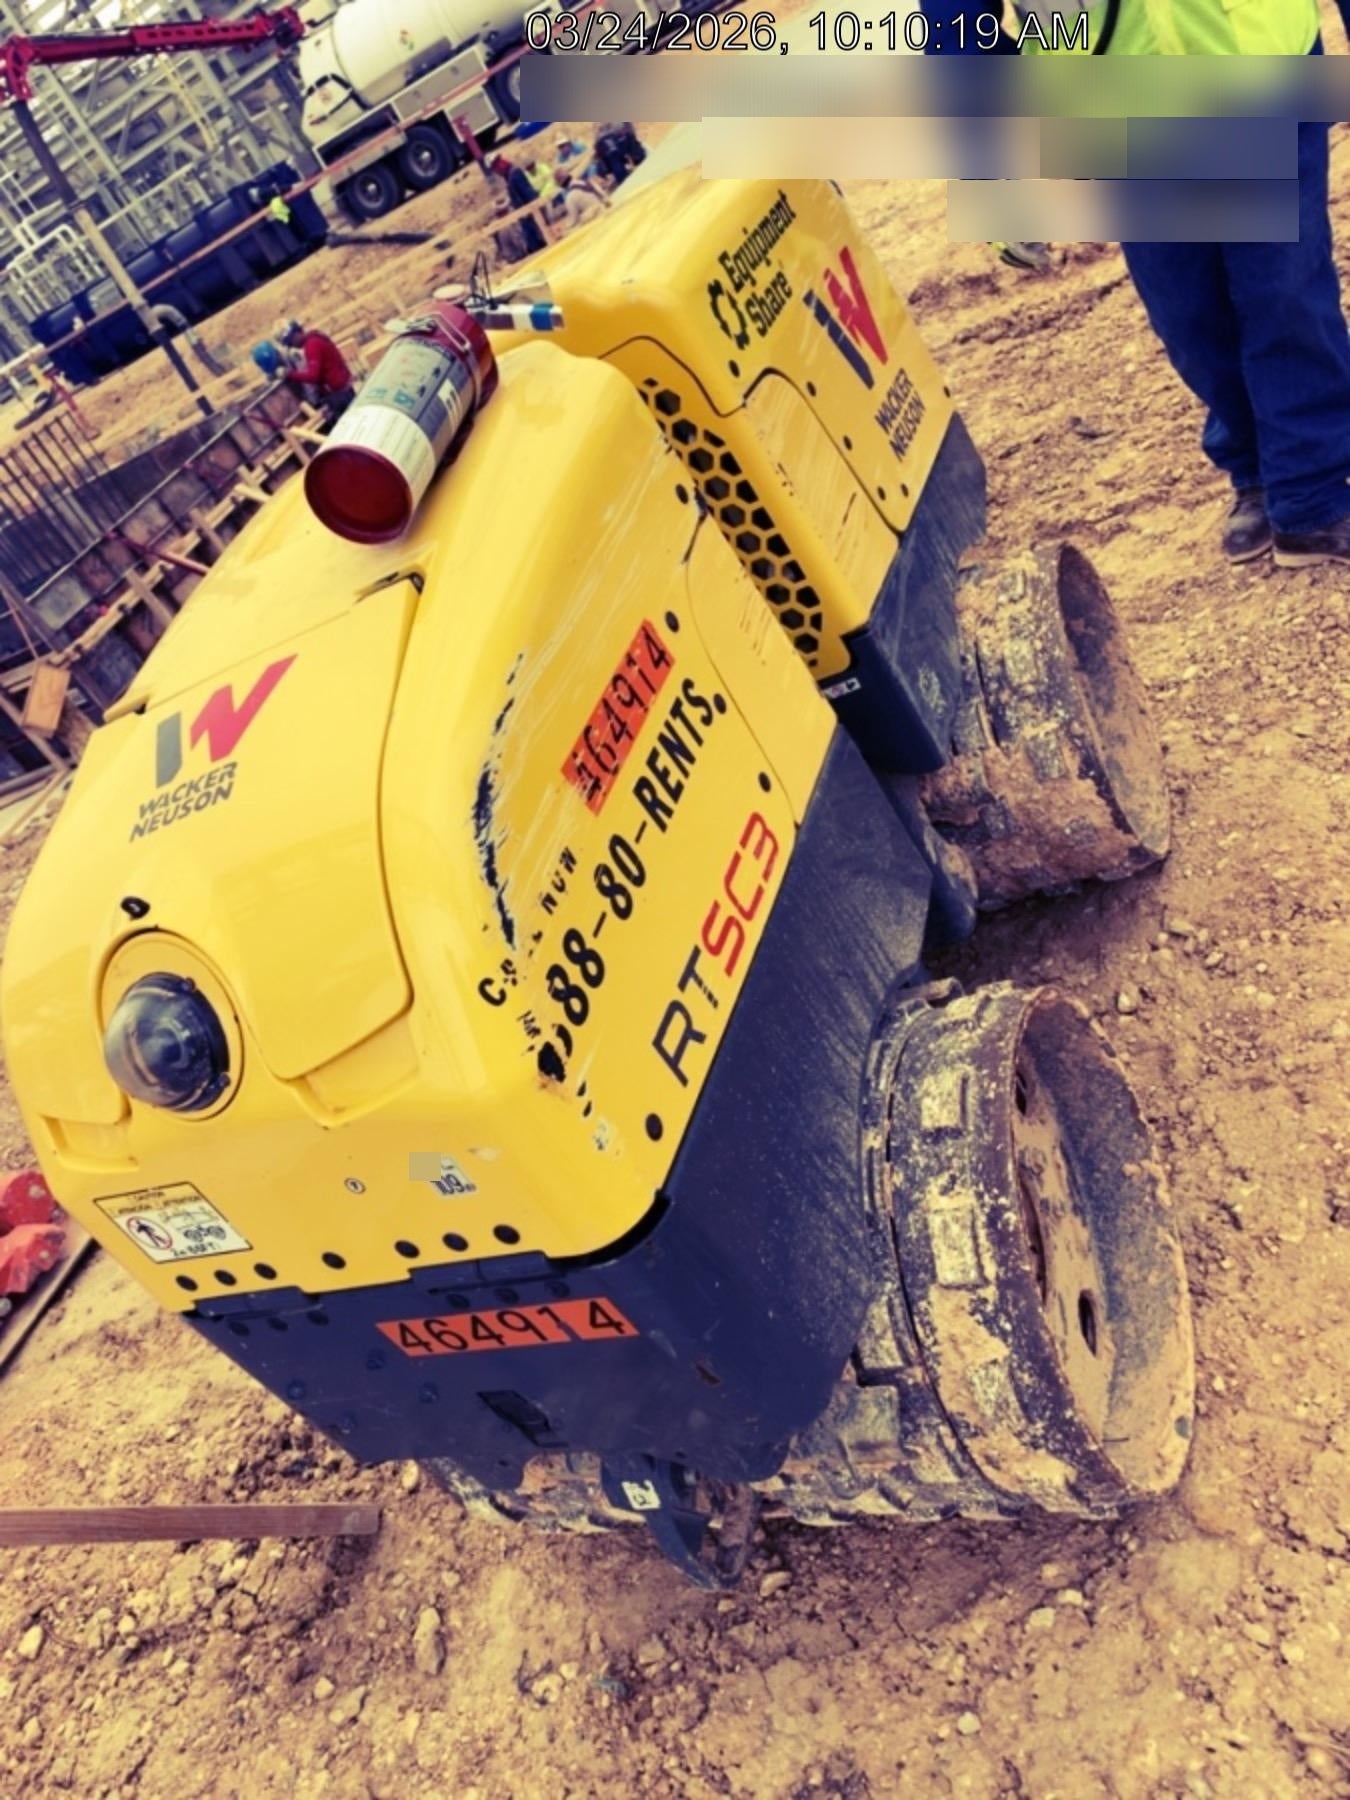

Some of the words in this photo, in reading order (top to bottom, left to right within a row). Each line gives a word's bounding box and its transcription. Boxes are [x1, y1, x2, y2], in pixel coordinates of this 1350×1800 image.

[718, 189, 797, 294] Equipment
[745, 270, 793, 338] Share
[874, 367, 915, 435] WACKER
[889, 390, 927, 463] NEUSON
[129, 781, 235, 844] NEUSON
[138, 760, 239, 820] WACKER
[398, 1299, 626, 1354] 464914
